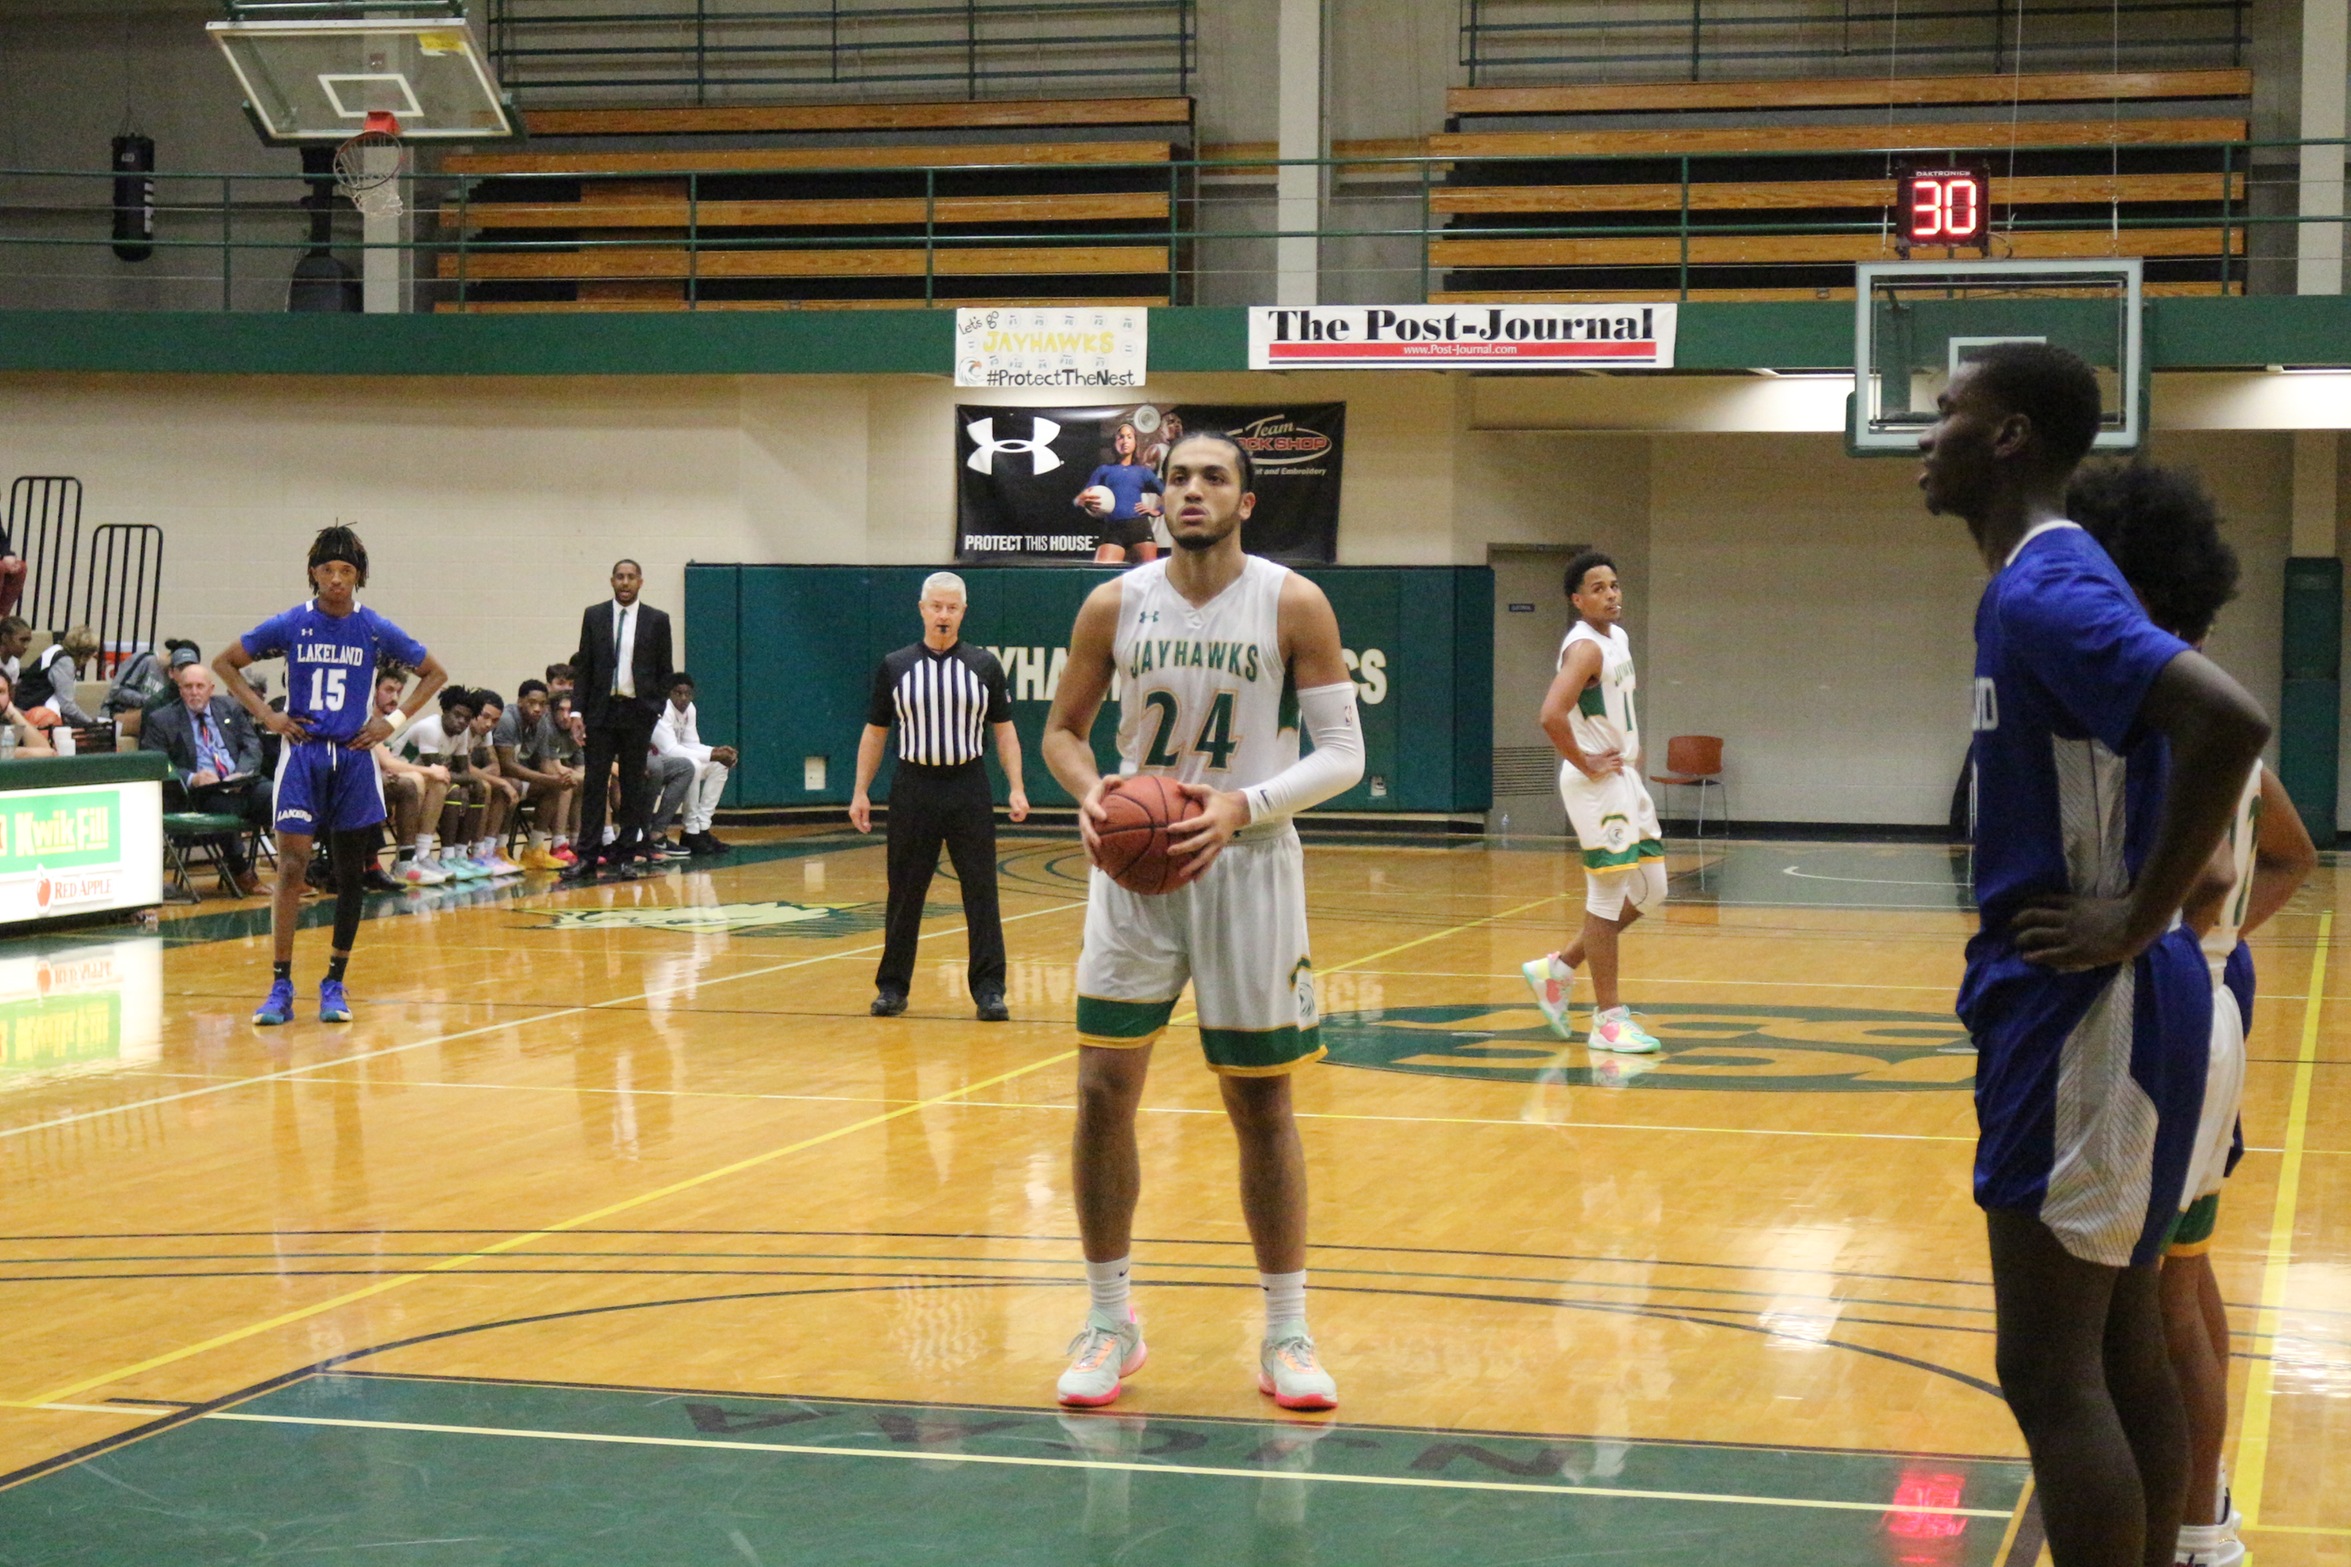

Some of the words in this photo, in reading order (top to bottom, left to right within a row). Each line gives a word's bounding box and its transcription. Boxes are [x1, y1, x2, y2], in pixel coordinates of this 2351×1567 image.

[1914, 180, 1977, 234] 30
[958, 316, 983, 335] Let's
[986, 311, 1000, 329] go
[1268, 309, 1350, 342] The
[1364, 308, 1654, 342] Post-Journal
[983, 331, 1115, 353] JAYHAWKS
[1403, 343, 1517, 355] www.Post-Journal.com
[987, 368, 1135, 386] #ProtectTheNest
[1245, 414, 1294, 438] Team
[1274, 437, 1328, 451] SHOP
[1263, 467, 1280, 475] and
[1281, 468, 1327, 477] Embroidery
[965, 535, 1022, 551] PROTECT
[1025, 535, 1048, 551] THIS
[297, 644, 364, 667] LAKELAND
[1130, 640, 1258, 682] JAYHAWKS
[309, 667, 347, 711] 15
[1139, 687, 1243, 772] 24
[14, 809, 76, 857] Kwik
[76, 806, 109, 850] Fill
[54, 881, 77, 899] RED
[80, 879, 112, 896] APPLE
